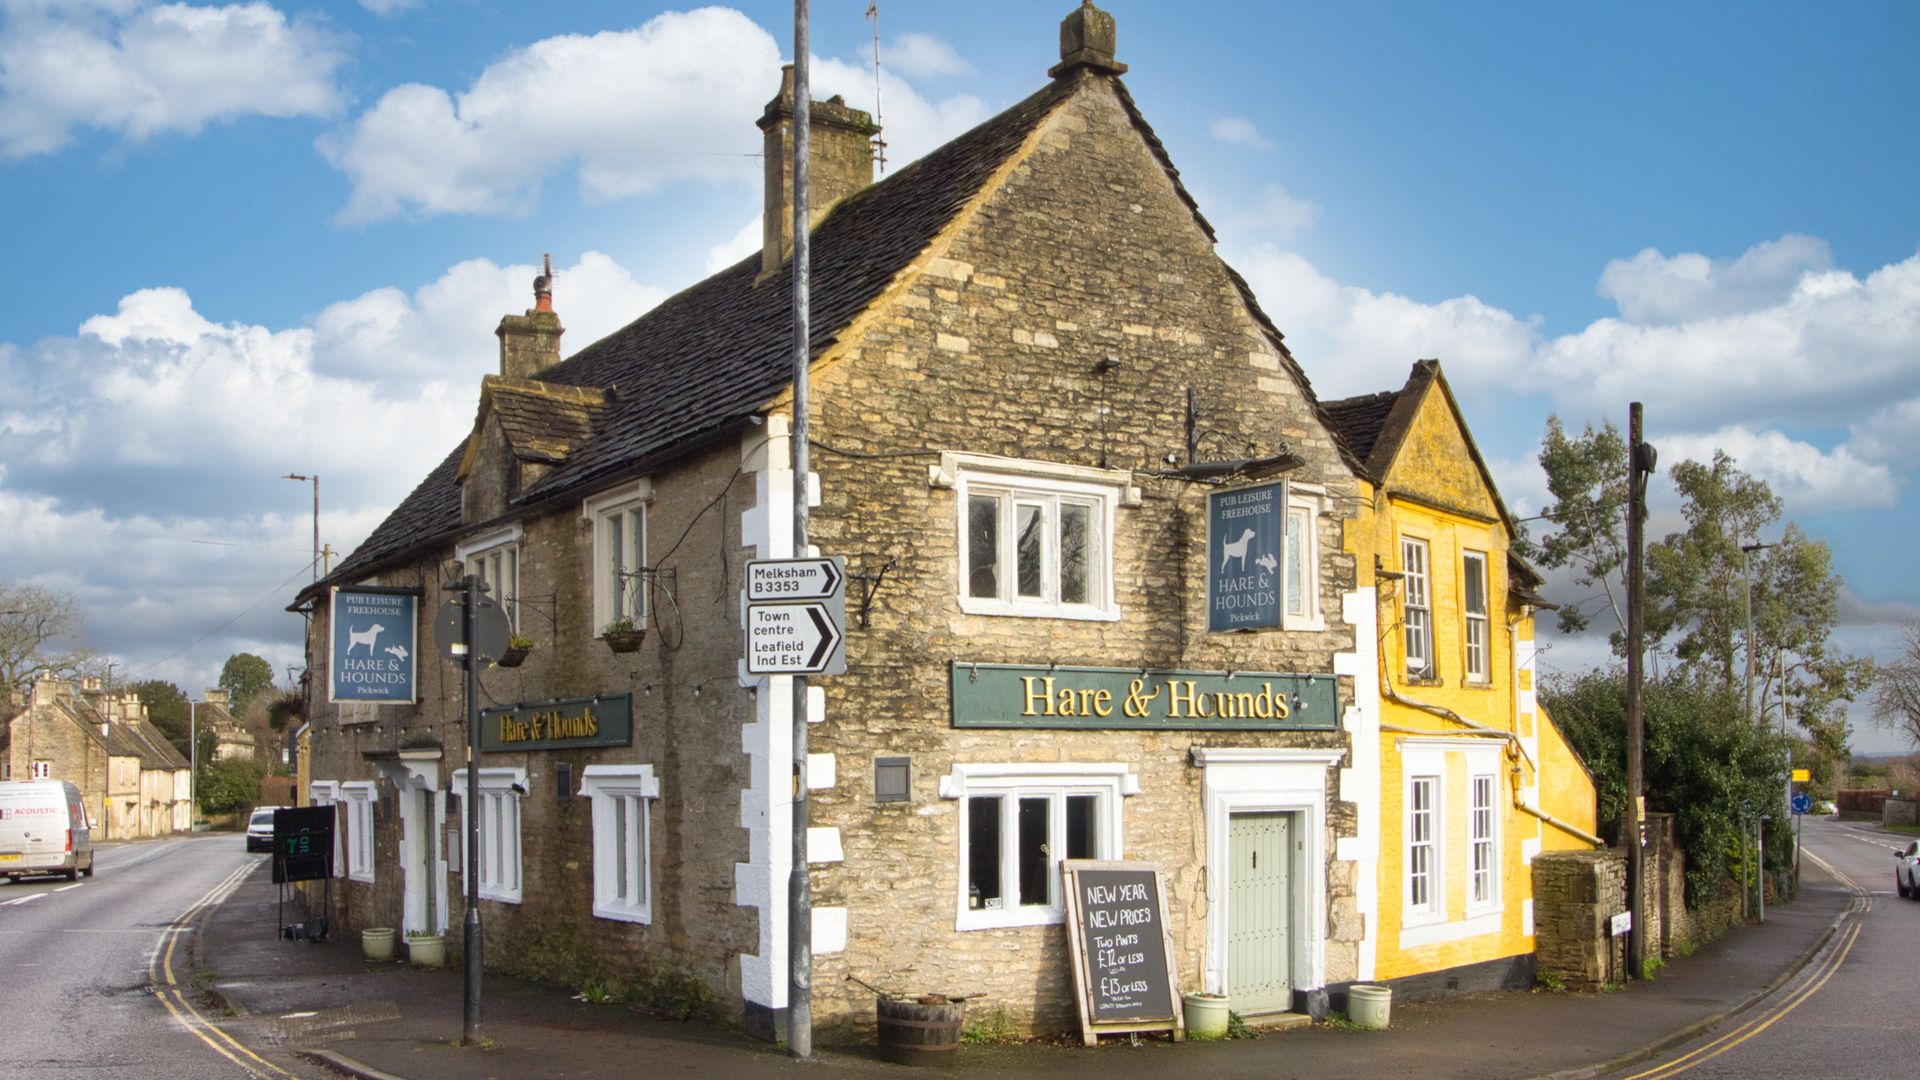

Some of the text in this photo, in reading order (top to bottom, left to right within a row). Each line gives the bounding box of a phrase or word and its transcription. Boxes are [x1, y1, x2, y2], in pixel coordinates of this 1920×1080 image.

[1220, 490, 1273, 507] PUB LEISURE
[1221, 503, 1272, 520] FREEHOUSE
[755, 568, 817, 579] Melksham
[1219, 572, 1270, 593] HARE &
[346, 595, 404, 606] PUB LEISURE
[1215, 591, 1276, 610] HOUNDS
[347, 606, 401, 616] FREEHOUSE
[758, 611, 790, 621] Town
[1230, 612, 1260, 623] Pickwick
[754, 625, 794, 635] centre
[755, 641, 804, 652] Leafield
[344, 659, 400, 671] HARE &
[757, 655, 802, 665] Ind Est
[341, 672, 406, 684] HOUNDS
[357, 686, 390, 694] Pickwick
[1022, 676, 1289, 719] Hare & Hounds
[500, 706, 598, 742] Hare & Hounds
[14, 807, 59, 815] ACOUSTIC
[1087, 884, 1148, 905] NEW YEAR
[1089, 907, 1151, 929] NEW PRICES
[1098, 948, 1117, 969] £12
[1128, 952, 1145, 964] LESS
[1101, 977, 1120, 997] £13
[1130, 980, 1148, 992] LESS
